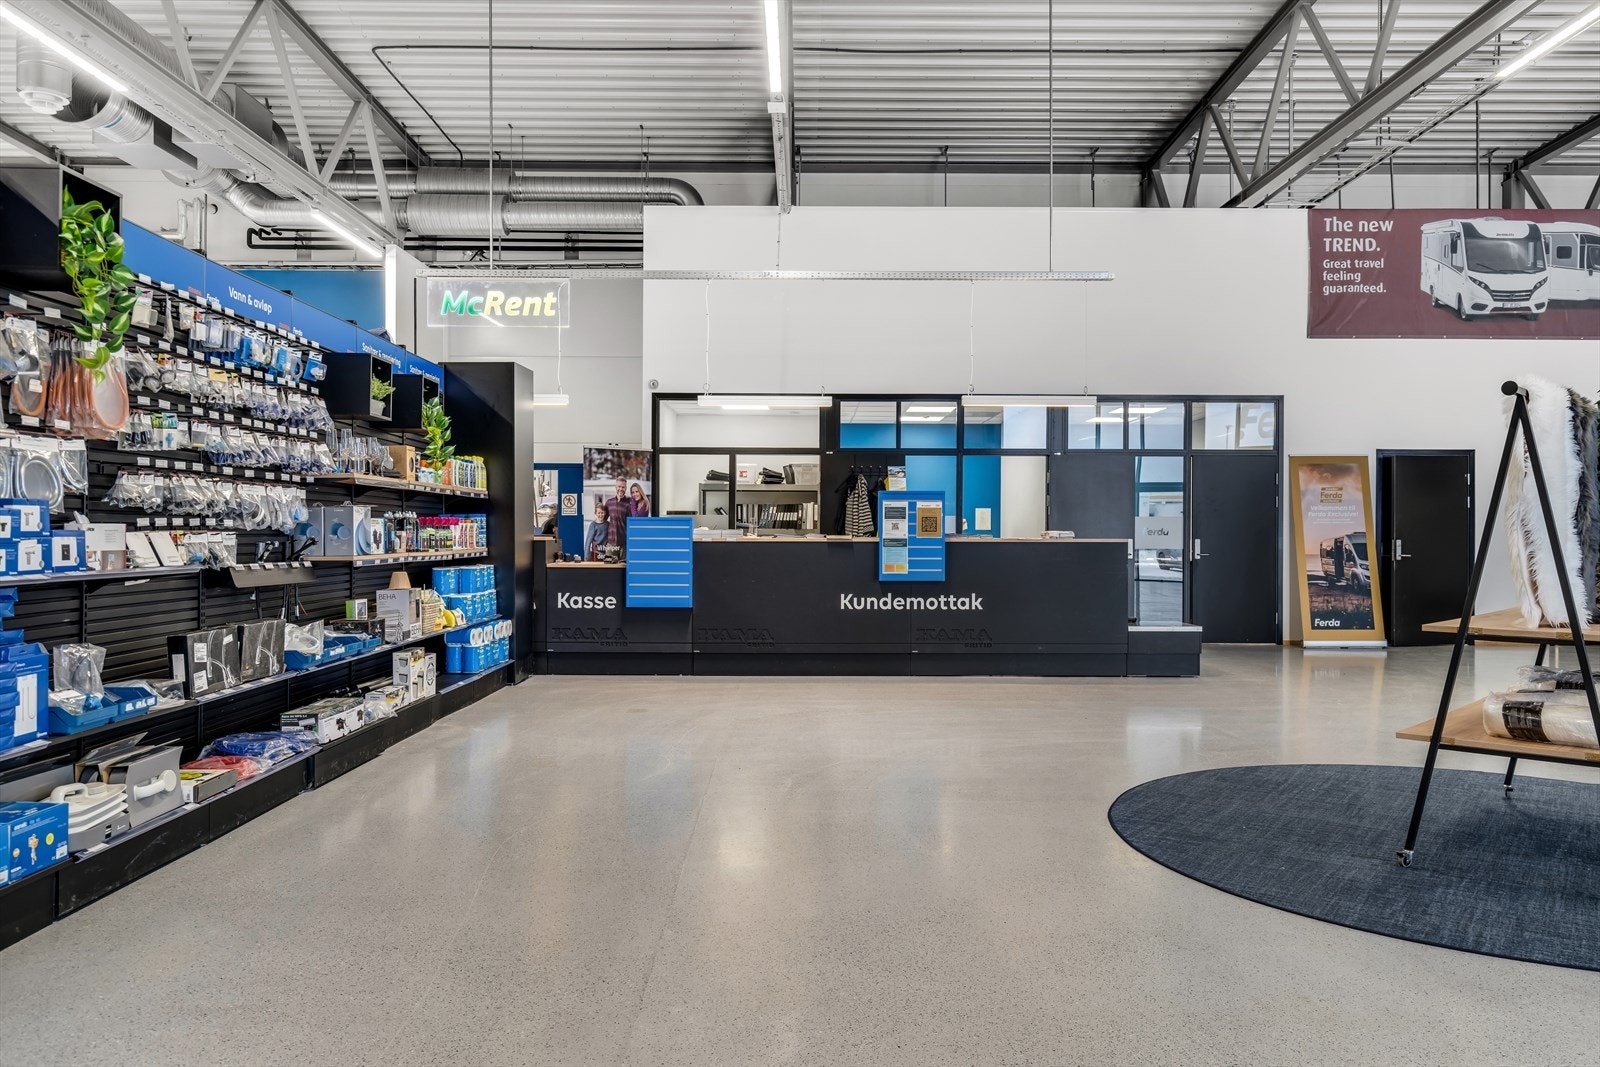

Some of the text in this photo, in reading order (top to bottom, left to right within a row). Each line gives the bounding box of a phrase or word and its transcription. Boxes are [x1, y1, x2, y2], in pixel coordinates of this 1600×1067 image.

[1323, 216, 1394, 232] The new
[1323, 237, 1380, 252] TREND.
[1323, 258, 1384, 269] Great travel
[1323, 270, 1361, 283] feeling
[1323, 282, 1387, 296] guaranteed.
[228, 286, 273, 315] Vann & avløp
[440, 290, 557, 317] McRent
[1320, 491, 1343, 499] Ferda
[557, 592, 617, 609] Kasse
[840, 592, 984, 610] Kundemottak
[1314, 618, 1341, 627] Ferda
[551, 627, 628, 640] KAMA
[915, 628, 993, 641] KAMA
